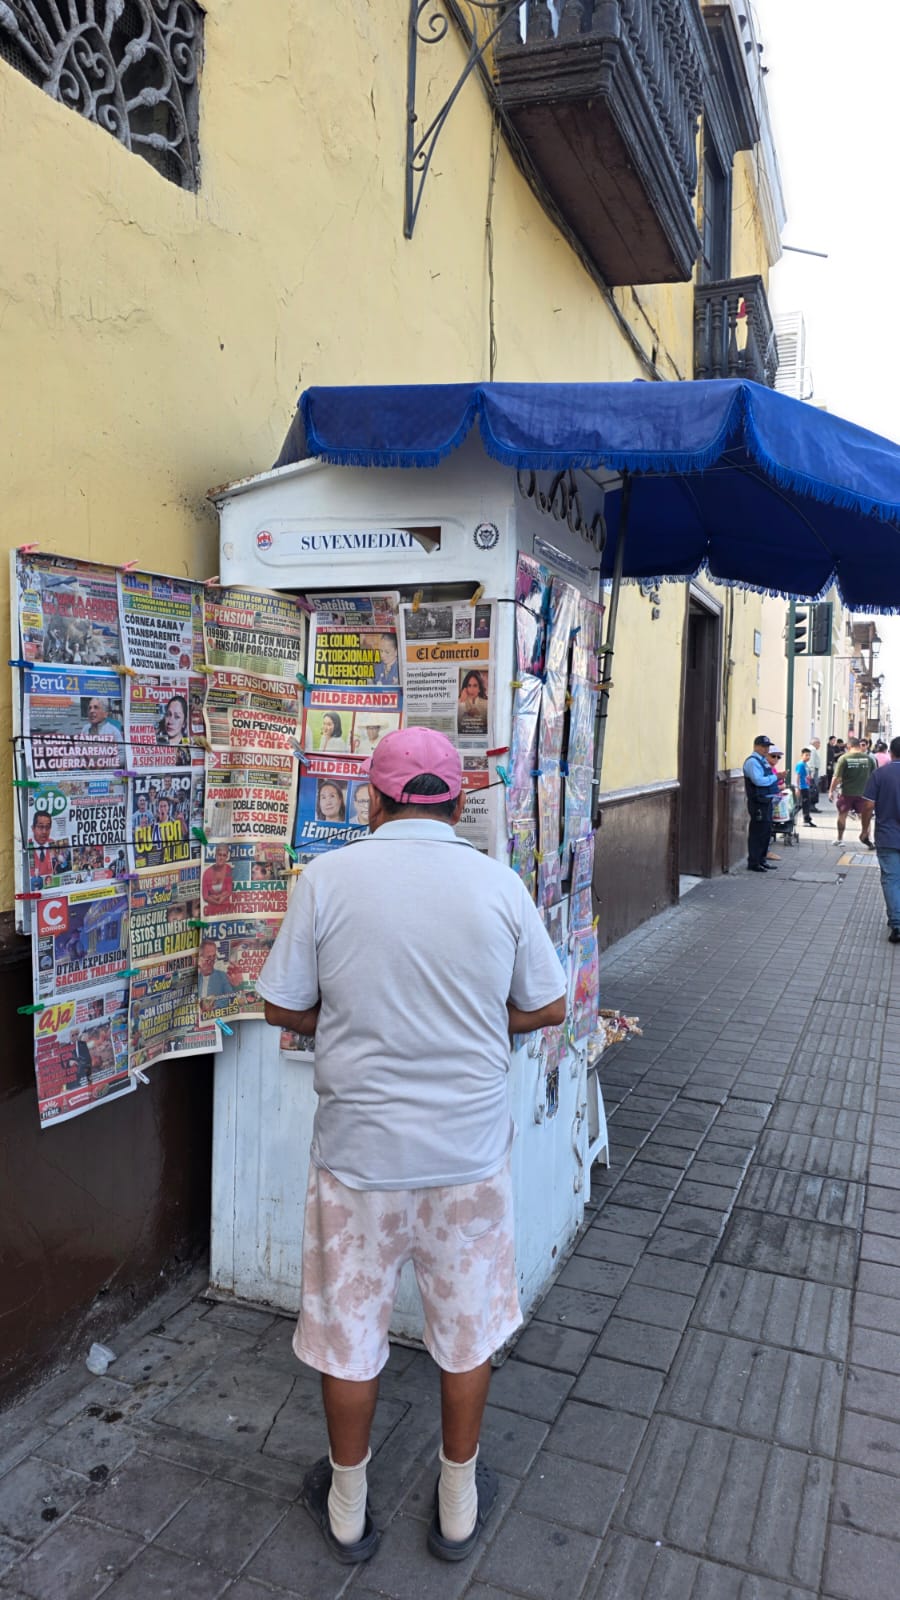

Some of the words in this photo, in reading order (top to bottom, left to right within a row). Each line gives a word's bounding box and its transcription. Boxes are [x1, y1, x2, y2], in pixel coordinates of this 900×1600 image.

[314, 597, 356, 611] Satélite
[125, 613, 155, 628] CÓRNEA
[157, 619, 178, 631] SANA
[179, 622, 185, 631] Y
[126, 626, 181, 642] TRANSPARENTE
[233, 631, 257, 644] TABLA
[258, 634, 275, 647] CON
[276, 638, 300, 651] NUEVA
[329, 634, 360, 647] COLMO:
[246, 644, 262, 656] POR
[315, 649, 374, 663] EXTORSIONAN
[374, 650, 381, 663] A
[416, 648, 429, 660] El
[431, 645, 480, 660] Comercio
[315, 663, 327, 676] LA
[328, 664, 375, 678] DEFENSORA
[217, 673, 228, 685] EL
[231, 673, 297, 696] PENSIONISTA
[132, 687, 143, 699] el
[145, 687, 187, 700] Popular
[311, 691, 398, 706] HILDEBRANDT
[232, 709, 297, 726] CRONOGRAMA
[230, 727, 285, 741] AUMENTADA
[232, 719, 251, 729] CON
[252, 720, 297, 736] PENSIÓN
[44, 735, 72, 745] GANA
[130, 735, 156, 745] MUERE
[33, 747, 45, 757] LE
[45, 745, 119, 757] DECLARAREMOS
[220, 752, 230, 765] EL
[34, 758, 47, 769] LA
[48, 758, 87, 769] GUERRA
[88, 759, 95, 768] A
[97, 756, 121, 767] CHILE
[309, 760, 369, 776] HILDEBRA
[135, 775, 191, 794] LÍBRO
[207, 787, 243, 800] APROBADO
[244, 788, 251, 799] Y
[252, 788, 262, 799] SE
[264, 789, 289, 802] PAGA:
[36, 791, 66, 816] ojo
[233, 800, 256, 810] DOBLE
[256, 800, 279, 812] BONO
[279, 803, 289, 813] DE
[69, 806, 126, 822] PROTESTAN
[251, 812, 277, 823] SOLES
[279, 814, 288, 825] TE
[77, 821, 97, 834] POR
[100, 818, 126, 832] CAOS
[232, 823, 251, 834] TOCA
[252, 823, 287, 836] COBRAR
[301, 820, 370, 843] ¡Empatad
[72, 831, 126, 848] ELECTORAL
[227, 844, 256, 862] alud
[180, 865, 200, 881] DIABE
[43, 900, 63, 926] C
[131, 909, 167, 928] CONSUME
[131, 926, 155, 943] ESTOS
[156, 918, 199, 937] ALIMENT
[203, 926, 216, 938] Mi
[218, 922, 247, 939] Salu
[132, 941, 153, 958] EVITA
[154, 938, 162, 953] EL
[164, 929, 199, 955] GLAUCO
[56, 969, 88, 987] SACUDE
[90, 959, 127, 978] TRUJILLO
[57, 960, 80, 975] OTRA
[203, 1005, 239, 1020] DIABETES
